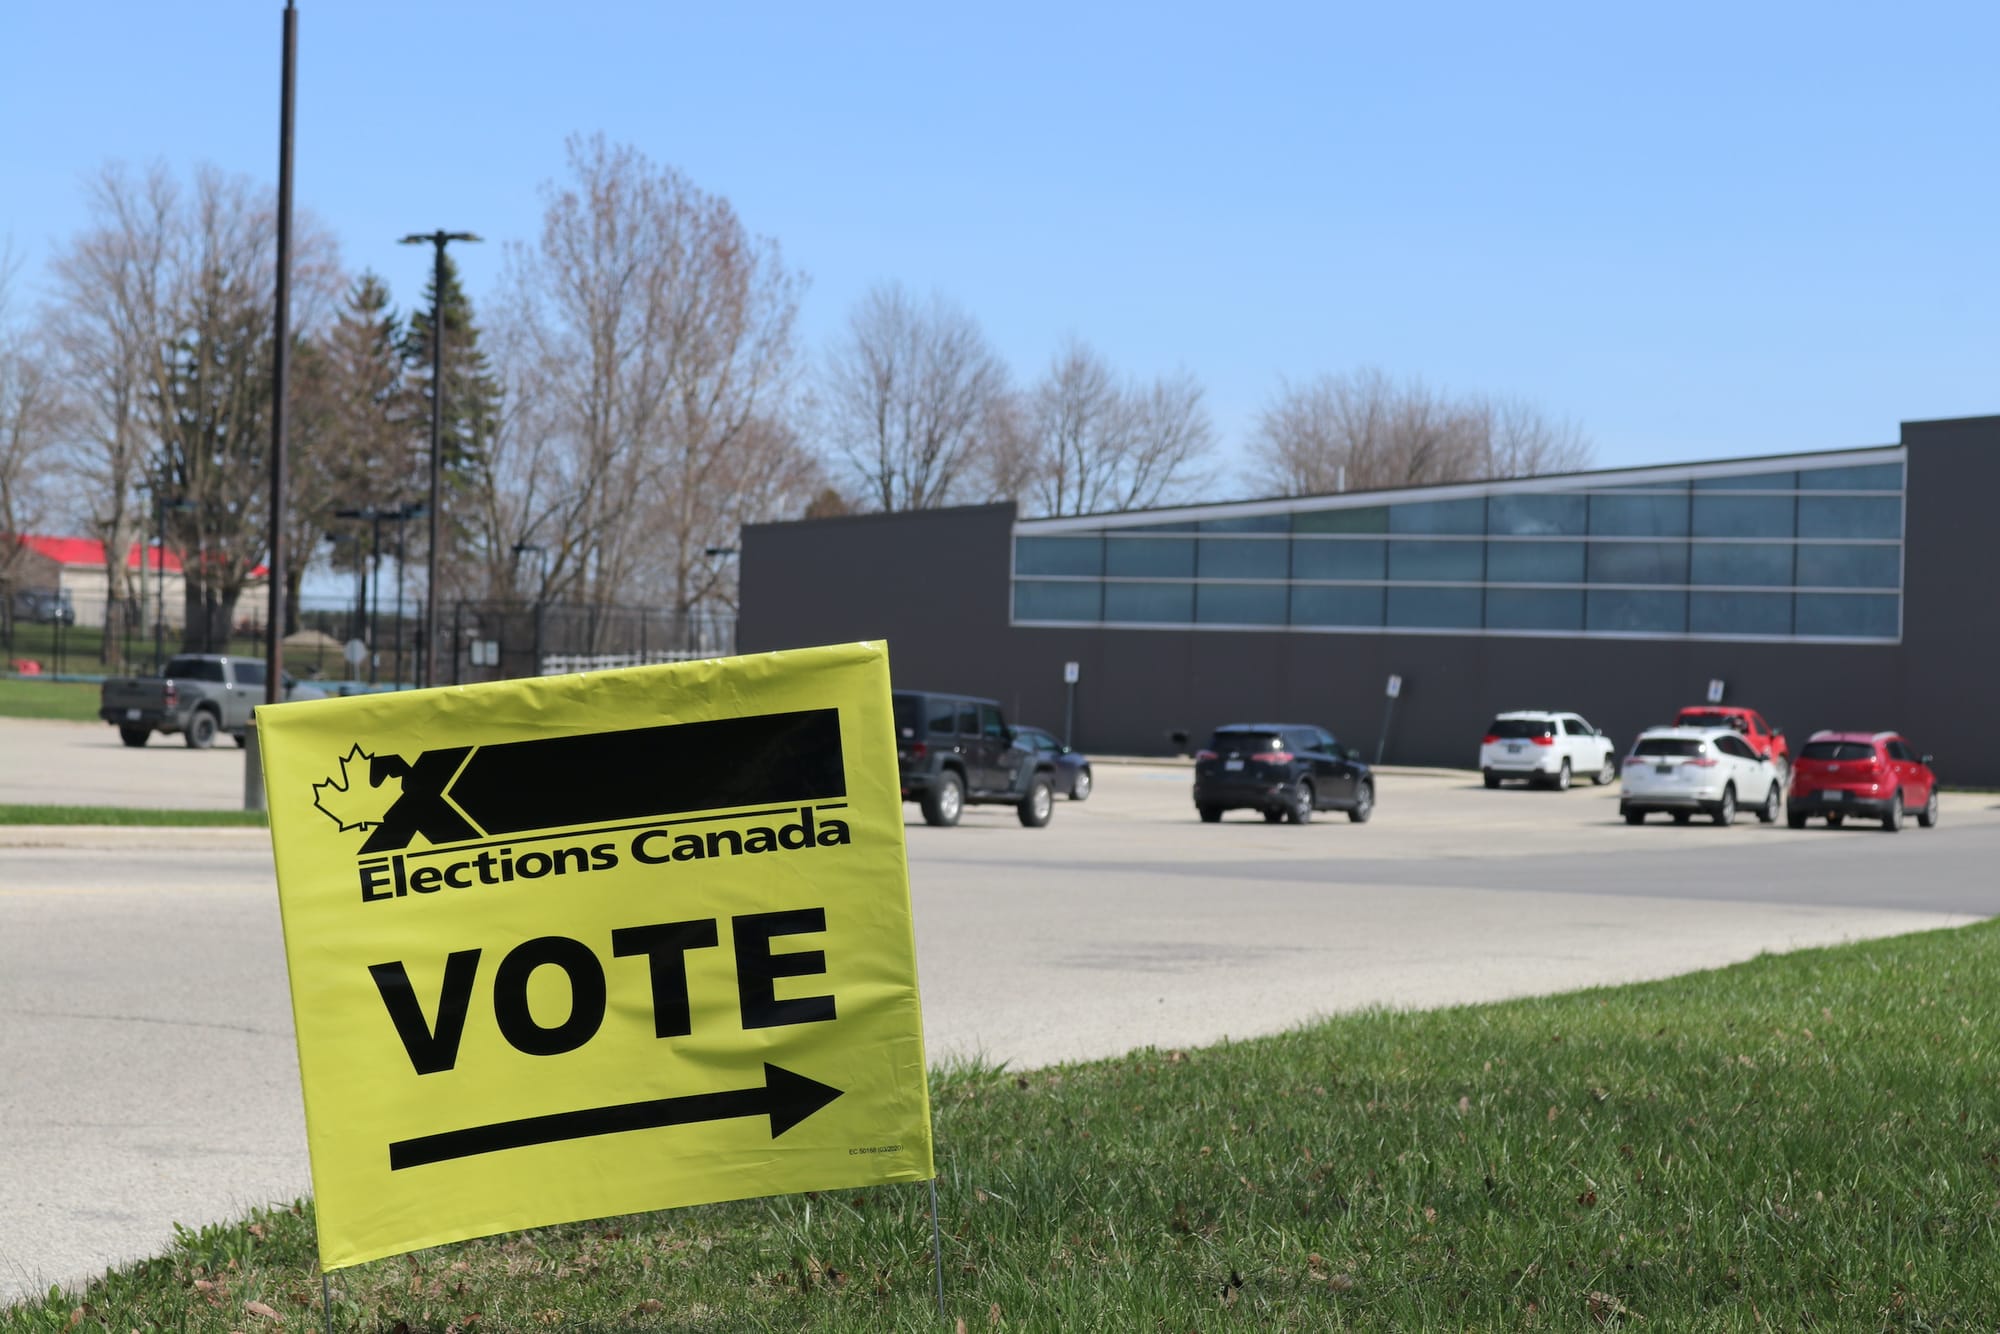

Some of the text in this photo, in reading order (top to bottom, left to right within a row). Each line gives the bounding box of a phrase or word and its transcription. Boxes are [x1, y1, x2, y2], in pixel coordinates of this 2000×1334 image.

[359, 805, 851, 903] Elections Canada
[367, 906, 838, 1076] VOTE
